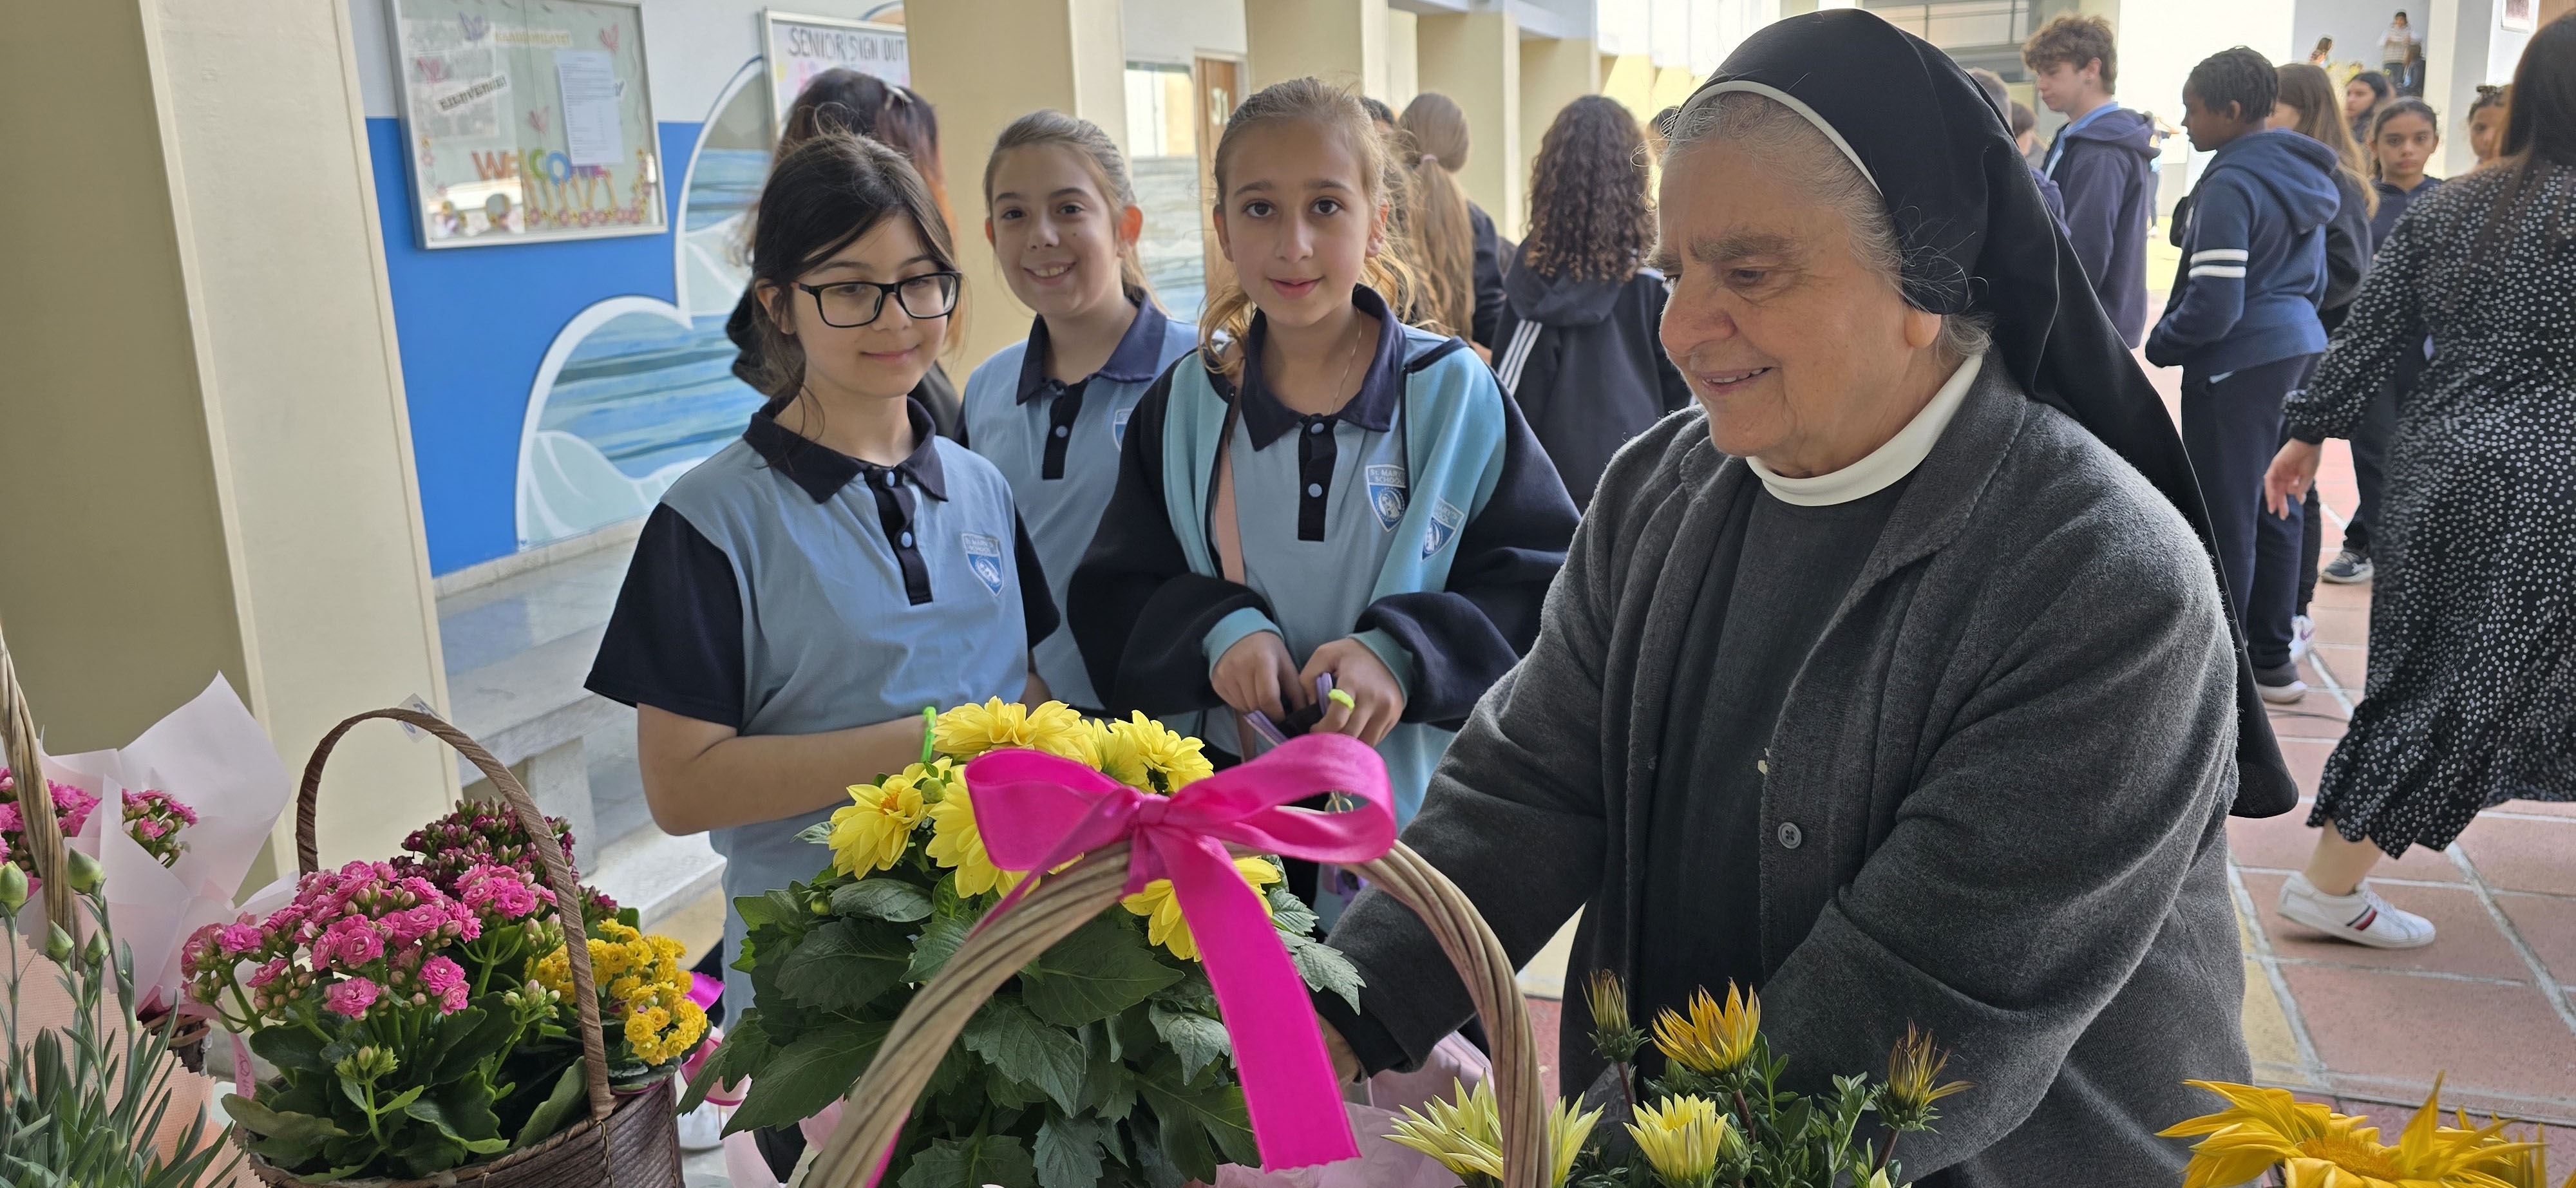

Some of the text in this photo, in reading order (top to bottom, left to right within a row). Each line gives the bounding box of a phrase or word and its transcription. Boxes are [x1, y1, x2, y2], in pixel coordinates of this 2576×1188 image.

[788, 26, 906, 62] SENIOR SIGN OUT
